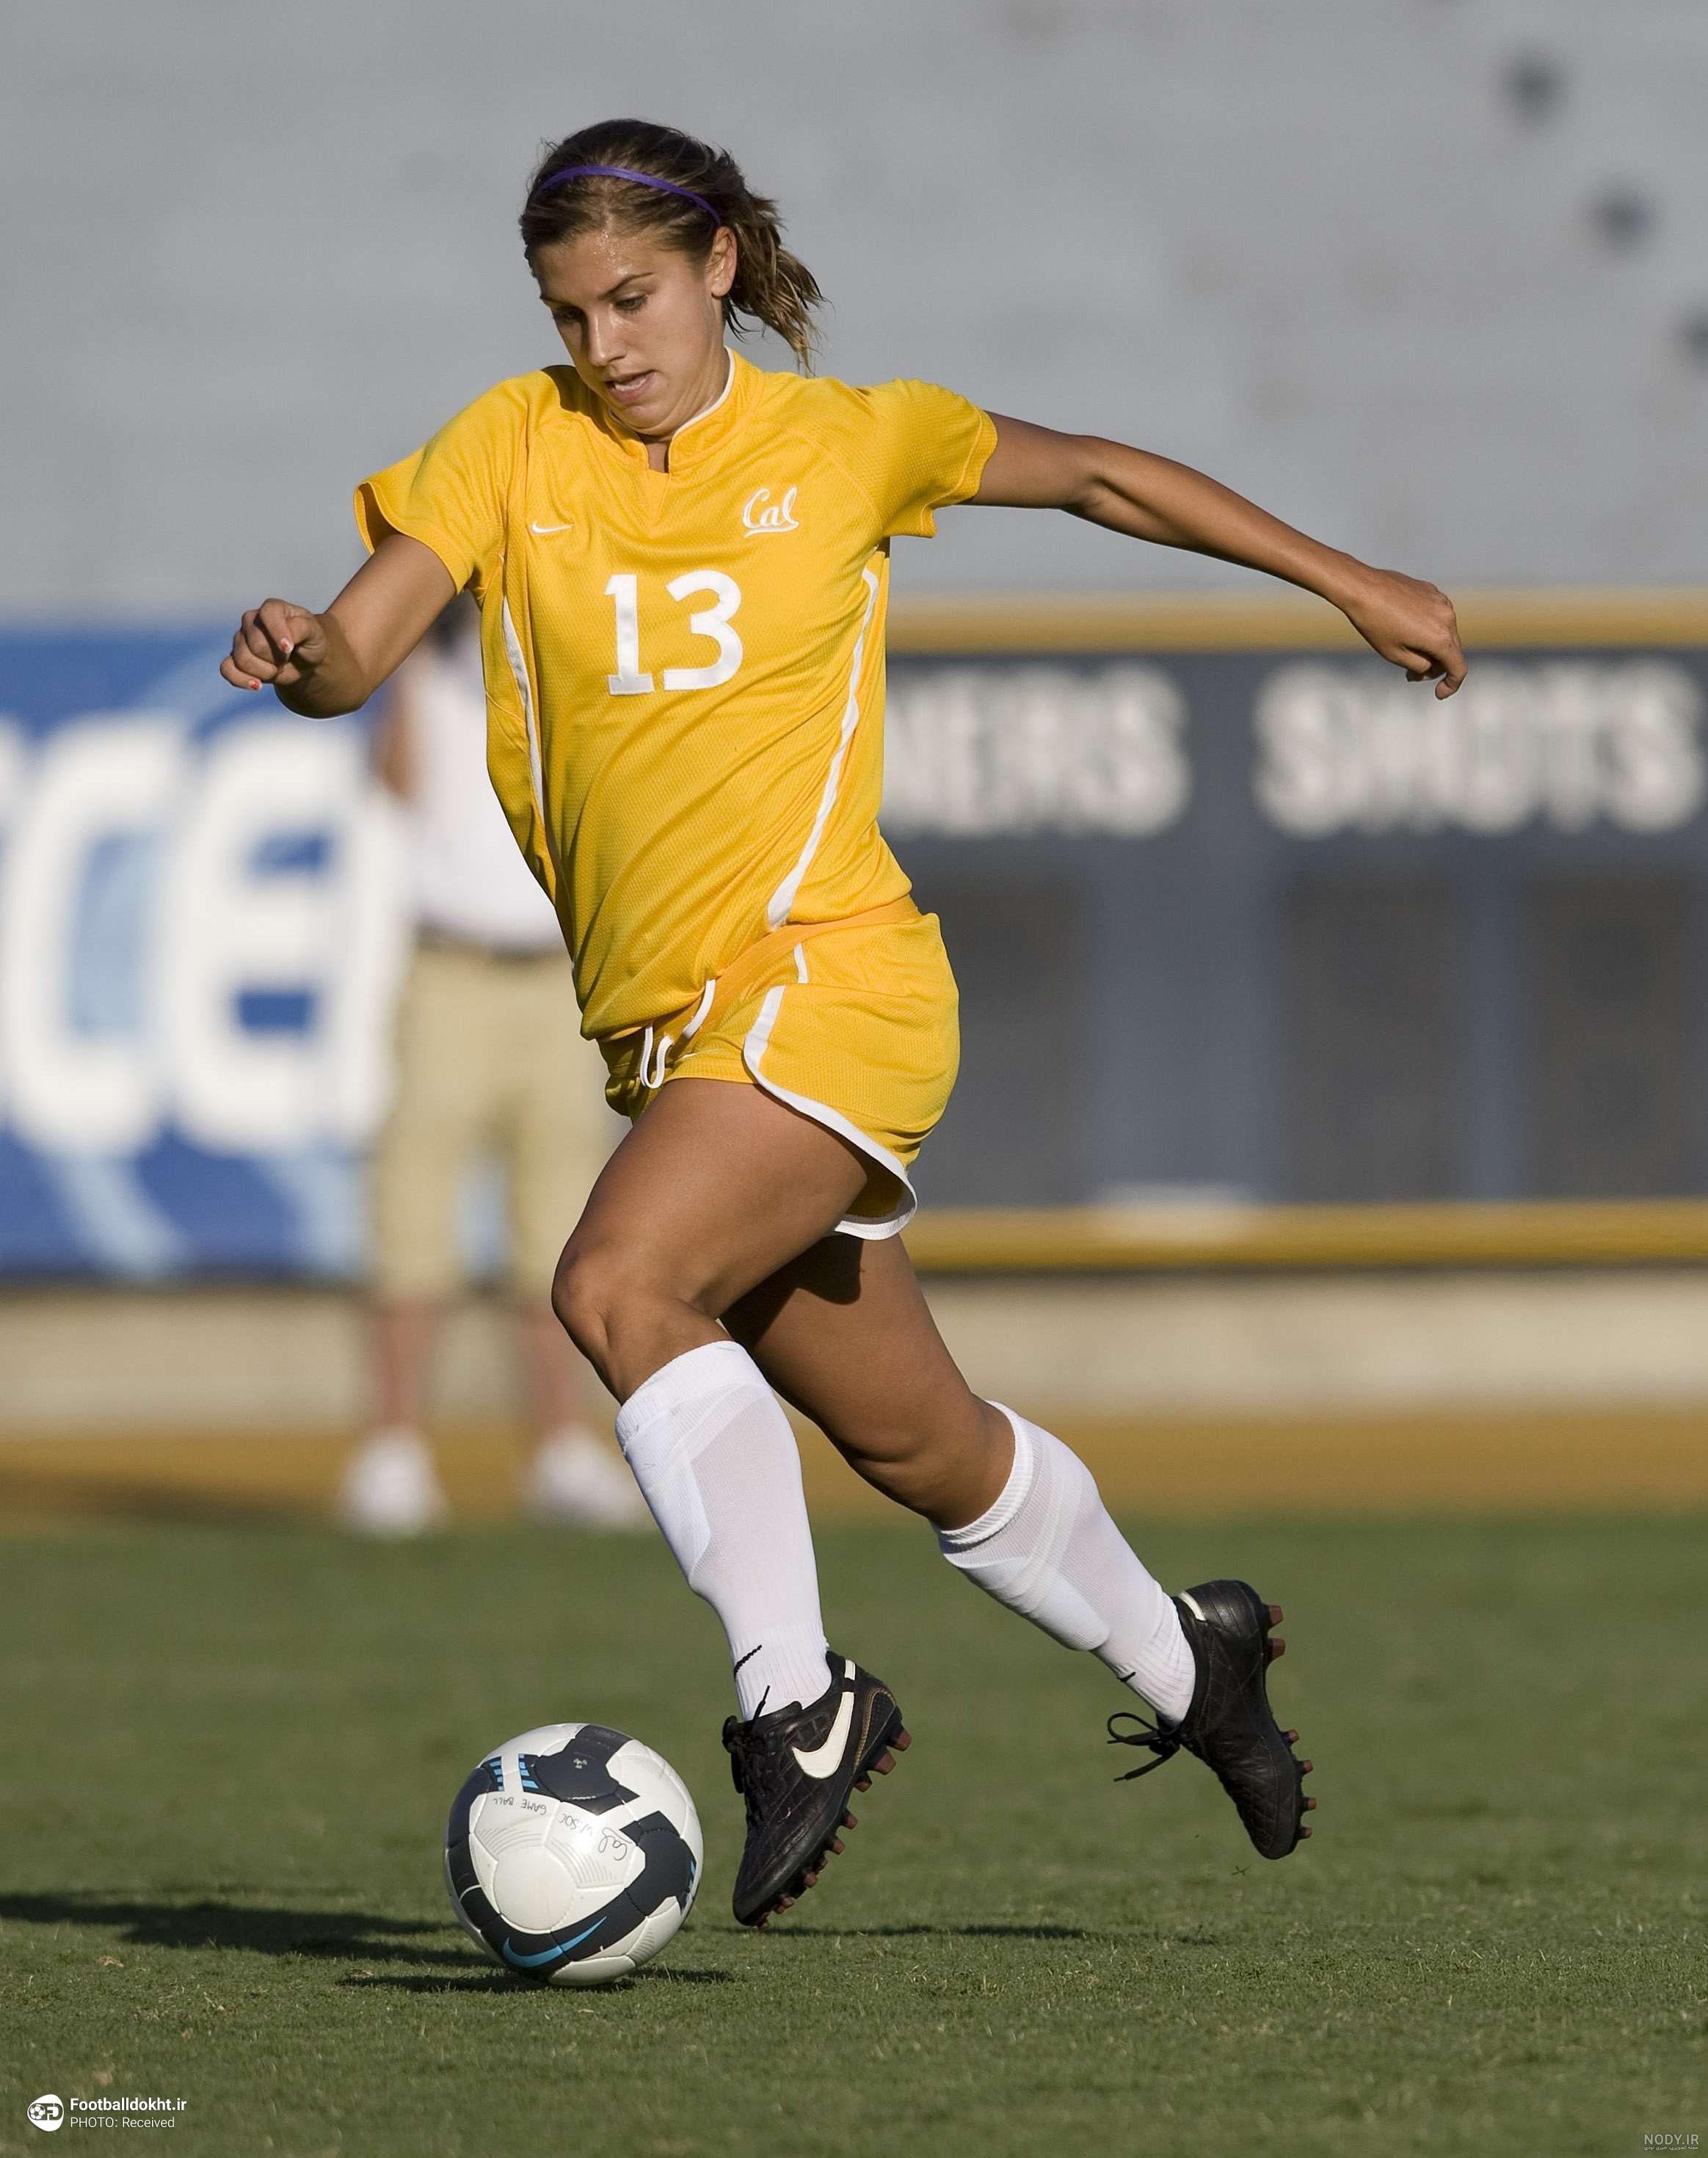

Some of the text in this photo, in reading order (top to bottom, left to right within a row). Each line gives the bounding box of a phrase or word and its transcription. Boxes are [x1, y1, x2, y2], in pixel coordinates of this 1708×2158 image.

[742, 485, 799, 538] Cal
[604, 570, 744, 696] 13
[1255, 662, 1703, 838] SHOTS
[493, 1796, 547, 1815] GAME BALL
